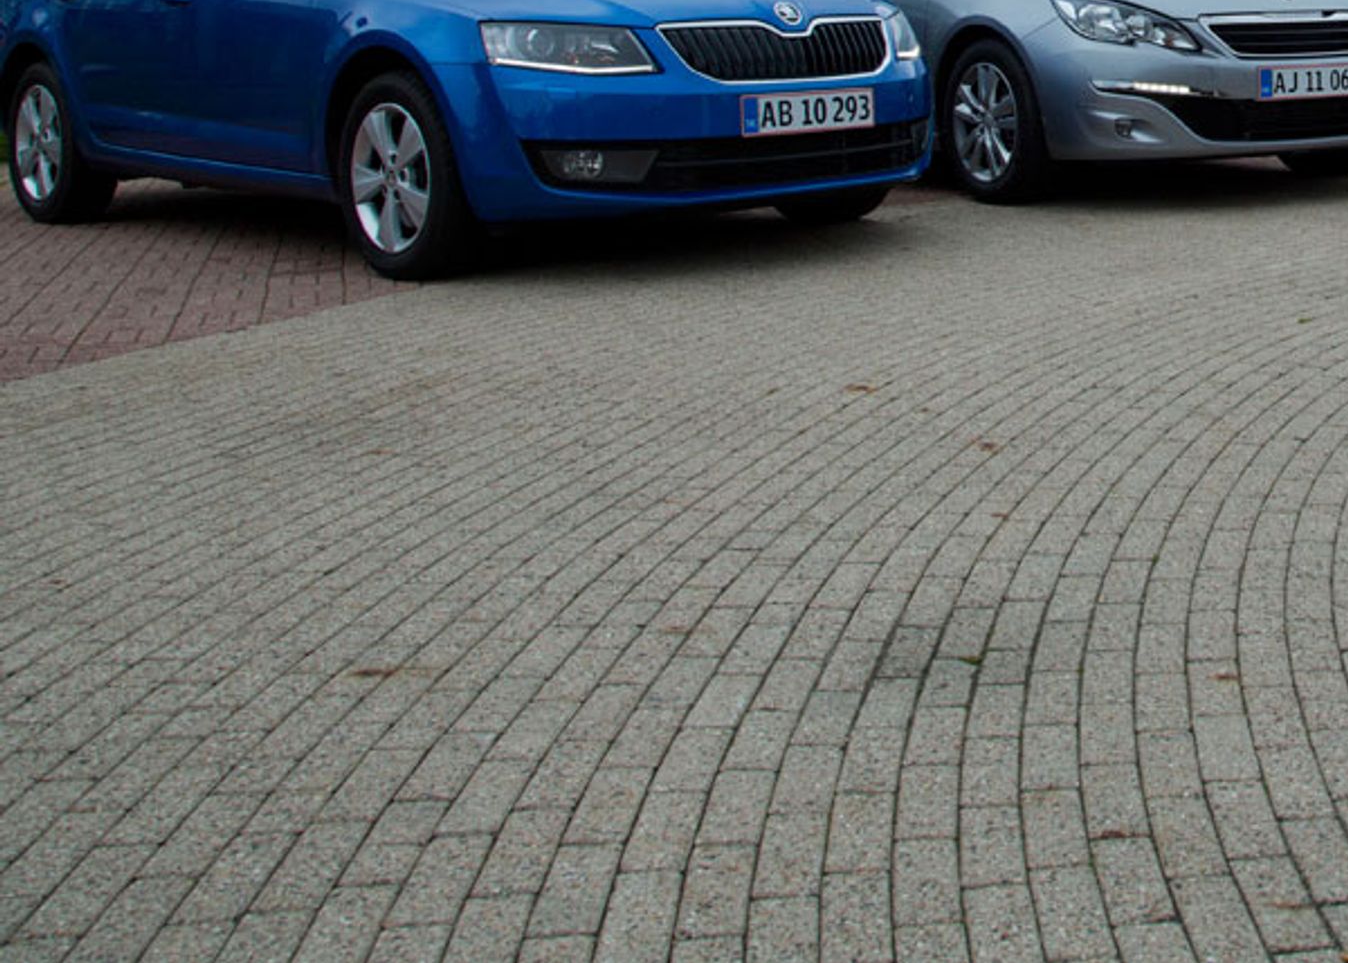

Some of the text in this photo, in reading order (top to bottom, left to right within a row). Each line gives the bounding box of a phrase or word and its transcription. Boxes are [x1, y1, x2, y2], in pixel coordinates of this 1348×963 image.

[1273, 70, 1299, 94] AJ
[1305, 70, 1324, 92] 11
[761, 94, 871, 128] AB 10 293
